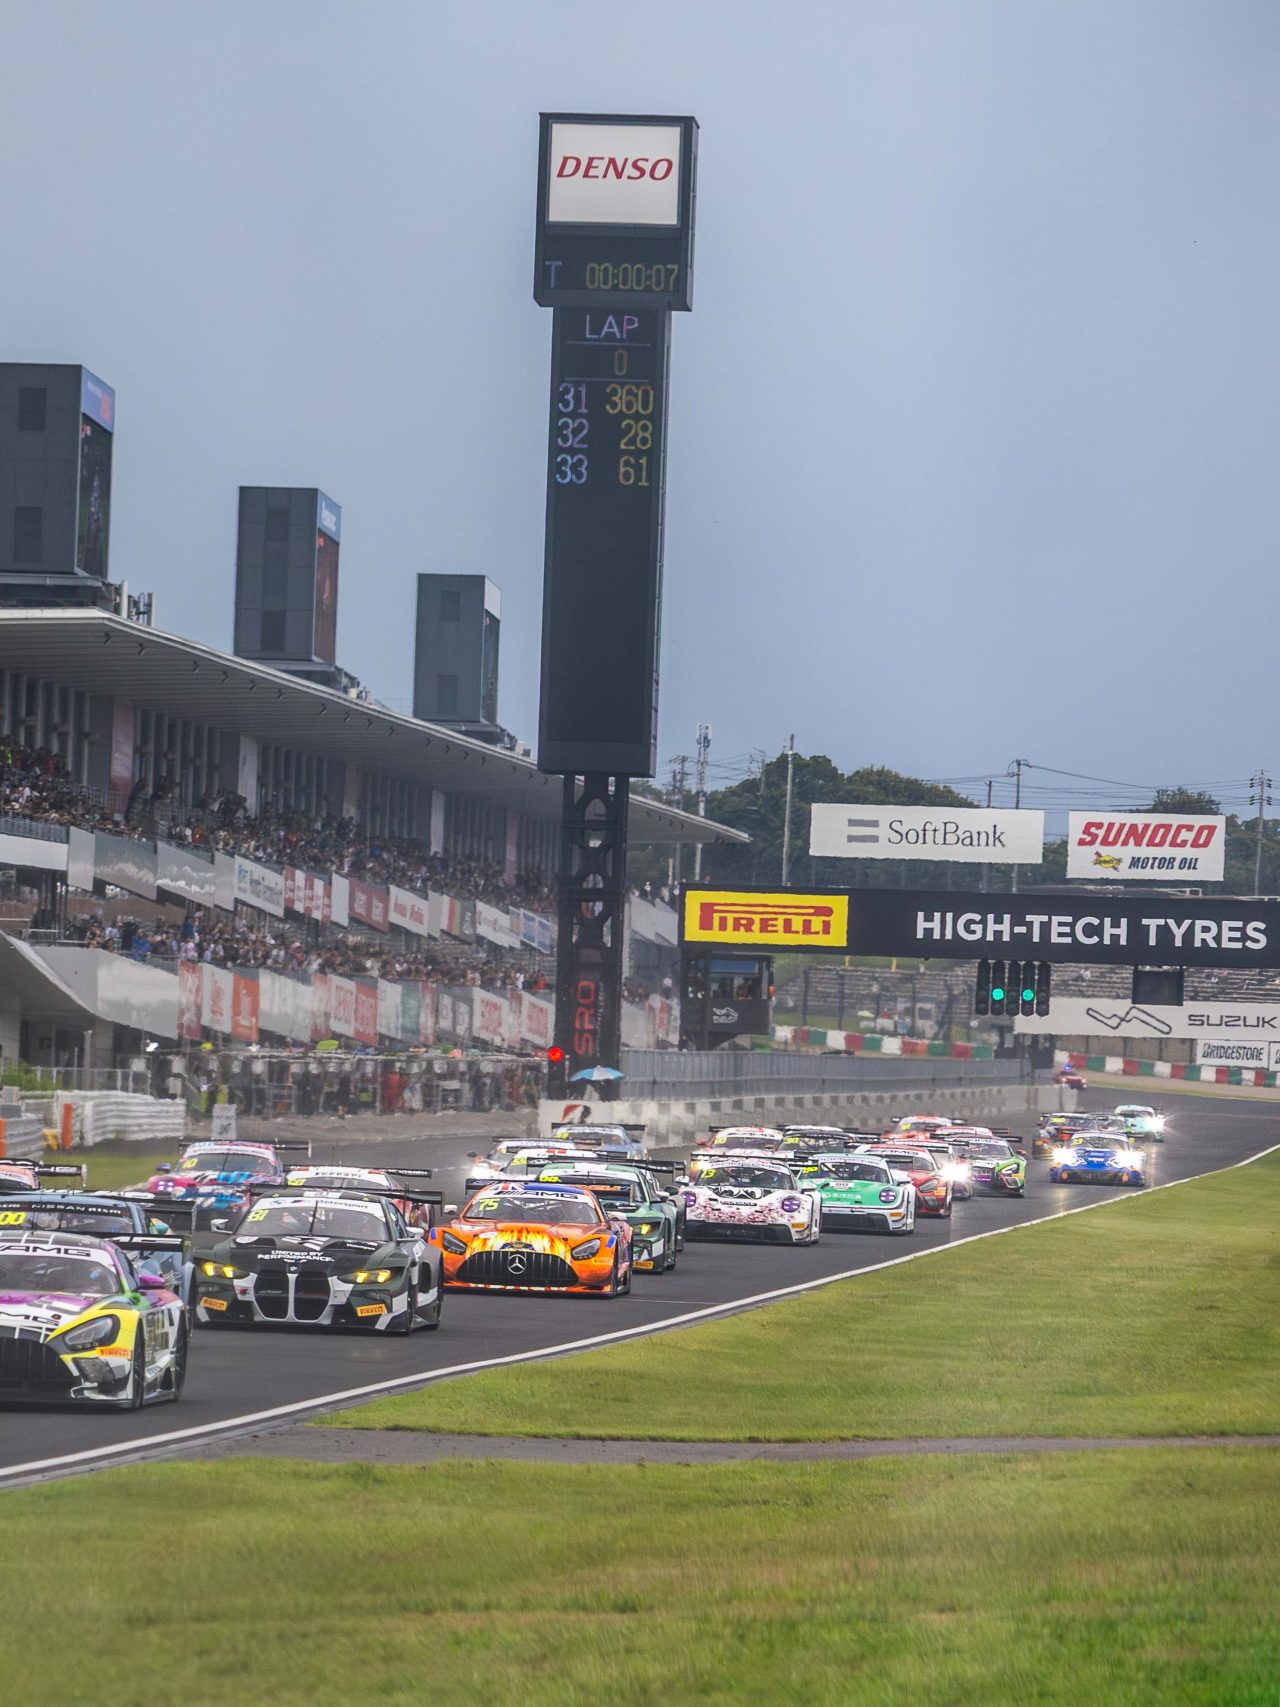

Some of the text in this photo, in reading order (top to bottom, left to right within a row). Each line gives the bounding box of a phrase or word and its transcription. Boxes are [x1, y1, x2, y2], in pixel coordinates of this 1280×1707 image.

[556, 155, 674, 181] DENSO
[544, 260, 679, 292] T 00:00:07
[585, 315, 639, 340] LAP
[614, 349, 628, 376] 0
[558, 383, 654, 415] 31 360
[557, 418, 652, 451] 32 28
[555, 454, 650, 487] 33 61
[887, 819, 1006, 848] SoftBank
[1077, 821, 1218, 849] SUNOCO
[1128, 856, 1199, 871] MOTOR OIL
[699, 902, 834, 935] PIRELLI
[916, 911, 1268, 950] HIGH-TECH TYRES
[574, 980, 596, 1056] SRO
[1202, 1042, 1264, 1062] BRIDGESTONE
[479, 1198, 500, 1211] 75
[0, 1245, 92, 1257] AMG
